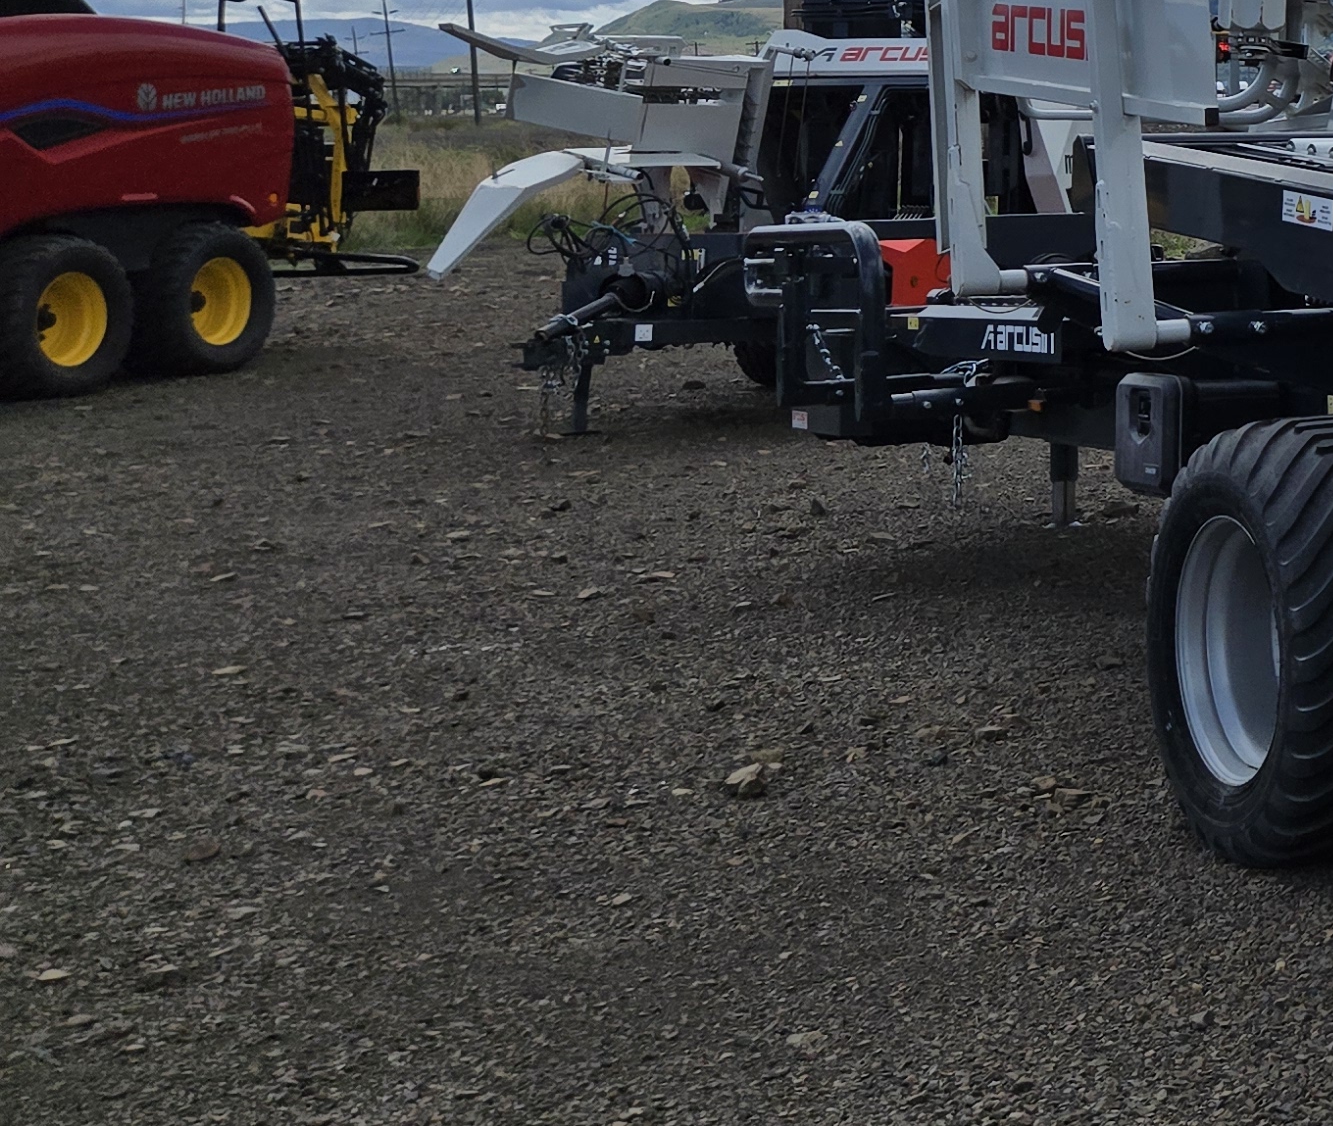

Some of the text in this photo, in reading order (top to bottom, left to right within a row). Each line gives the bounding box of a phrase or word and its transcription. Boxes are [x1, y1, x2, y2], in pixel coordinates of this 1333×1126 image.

[991, 3, 1088, 62] arcus
[162, 85, 266, 110] NEW HOLLAND
